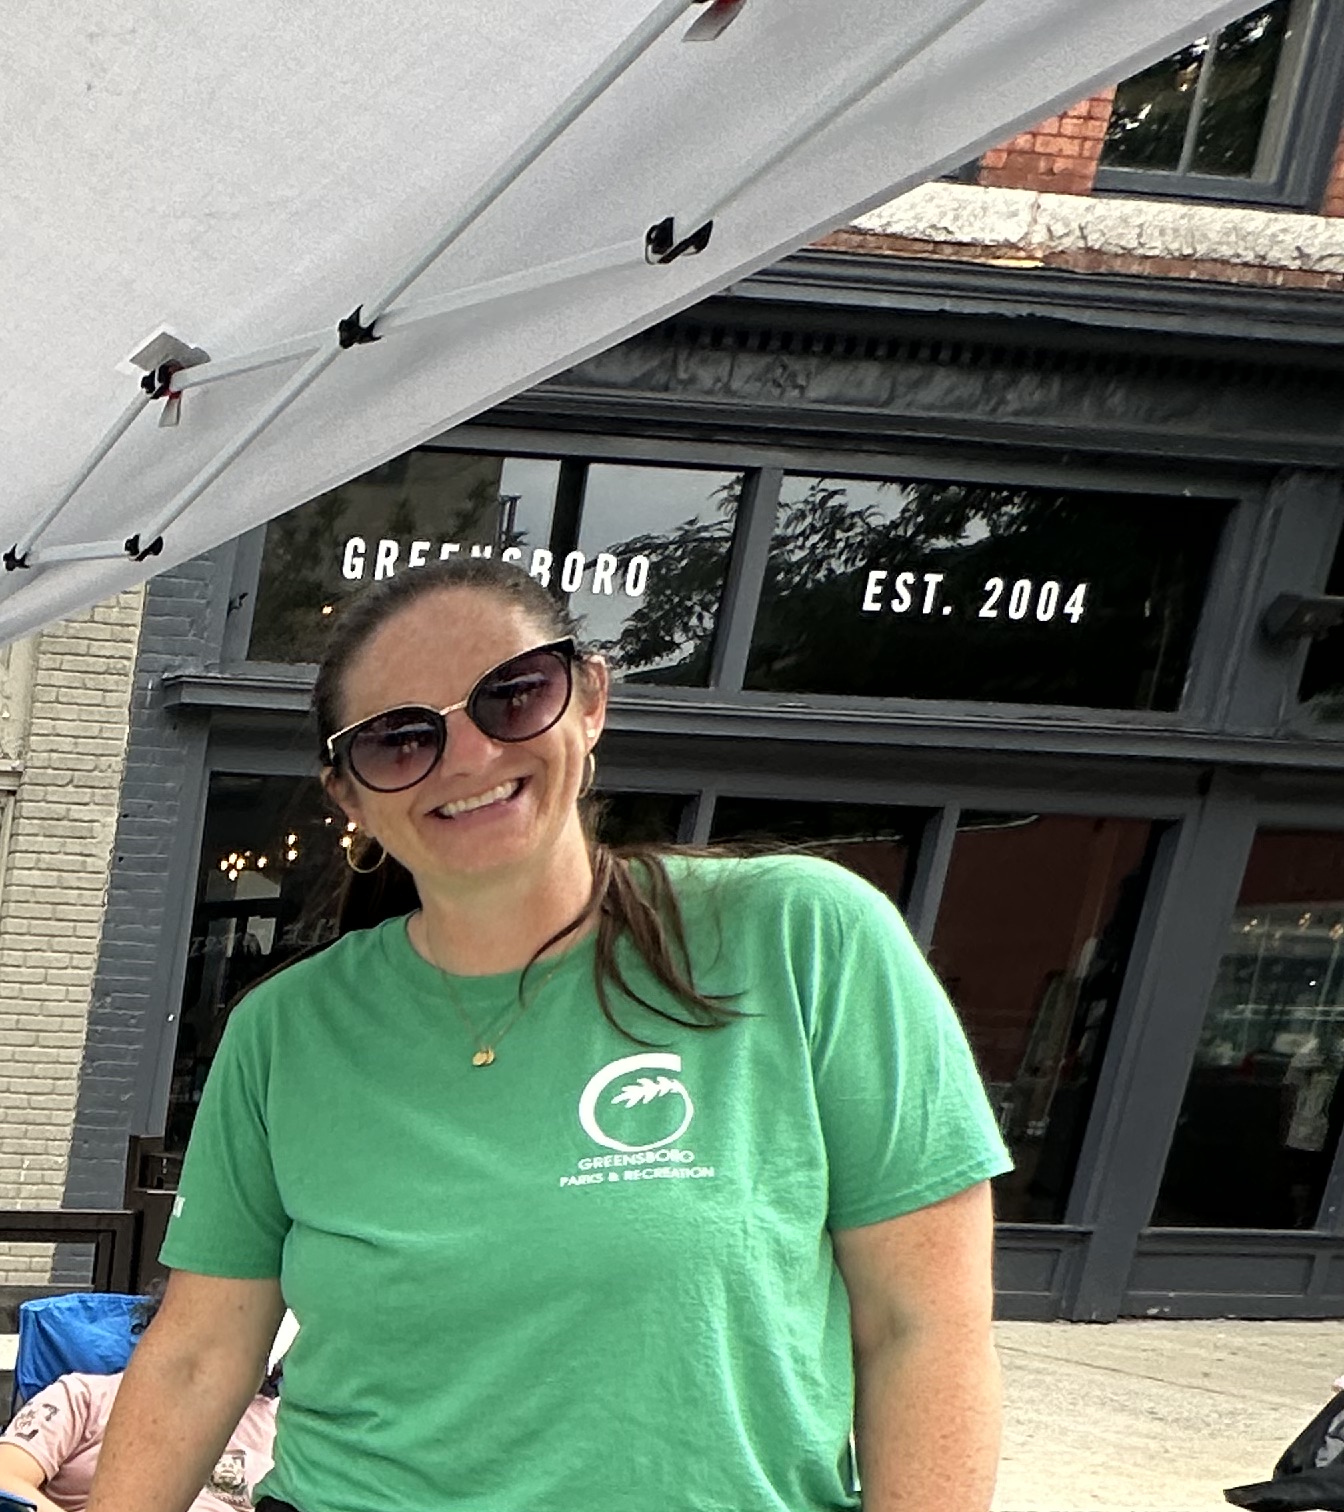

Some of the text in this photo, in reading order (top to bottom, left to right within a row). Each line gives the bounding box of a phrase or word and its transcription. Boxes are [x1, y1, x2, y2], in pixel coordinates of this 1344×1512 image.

[343, 537, 649, 597] GREBORO
[863, 571, 1087, 623] EST. 2004
[560, 1172, 604, 1187] PARKS
[623, 1166, 715, 1180] RECREATION
[578, 1149, 695, 1170] GREENSBORO
